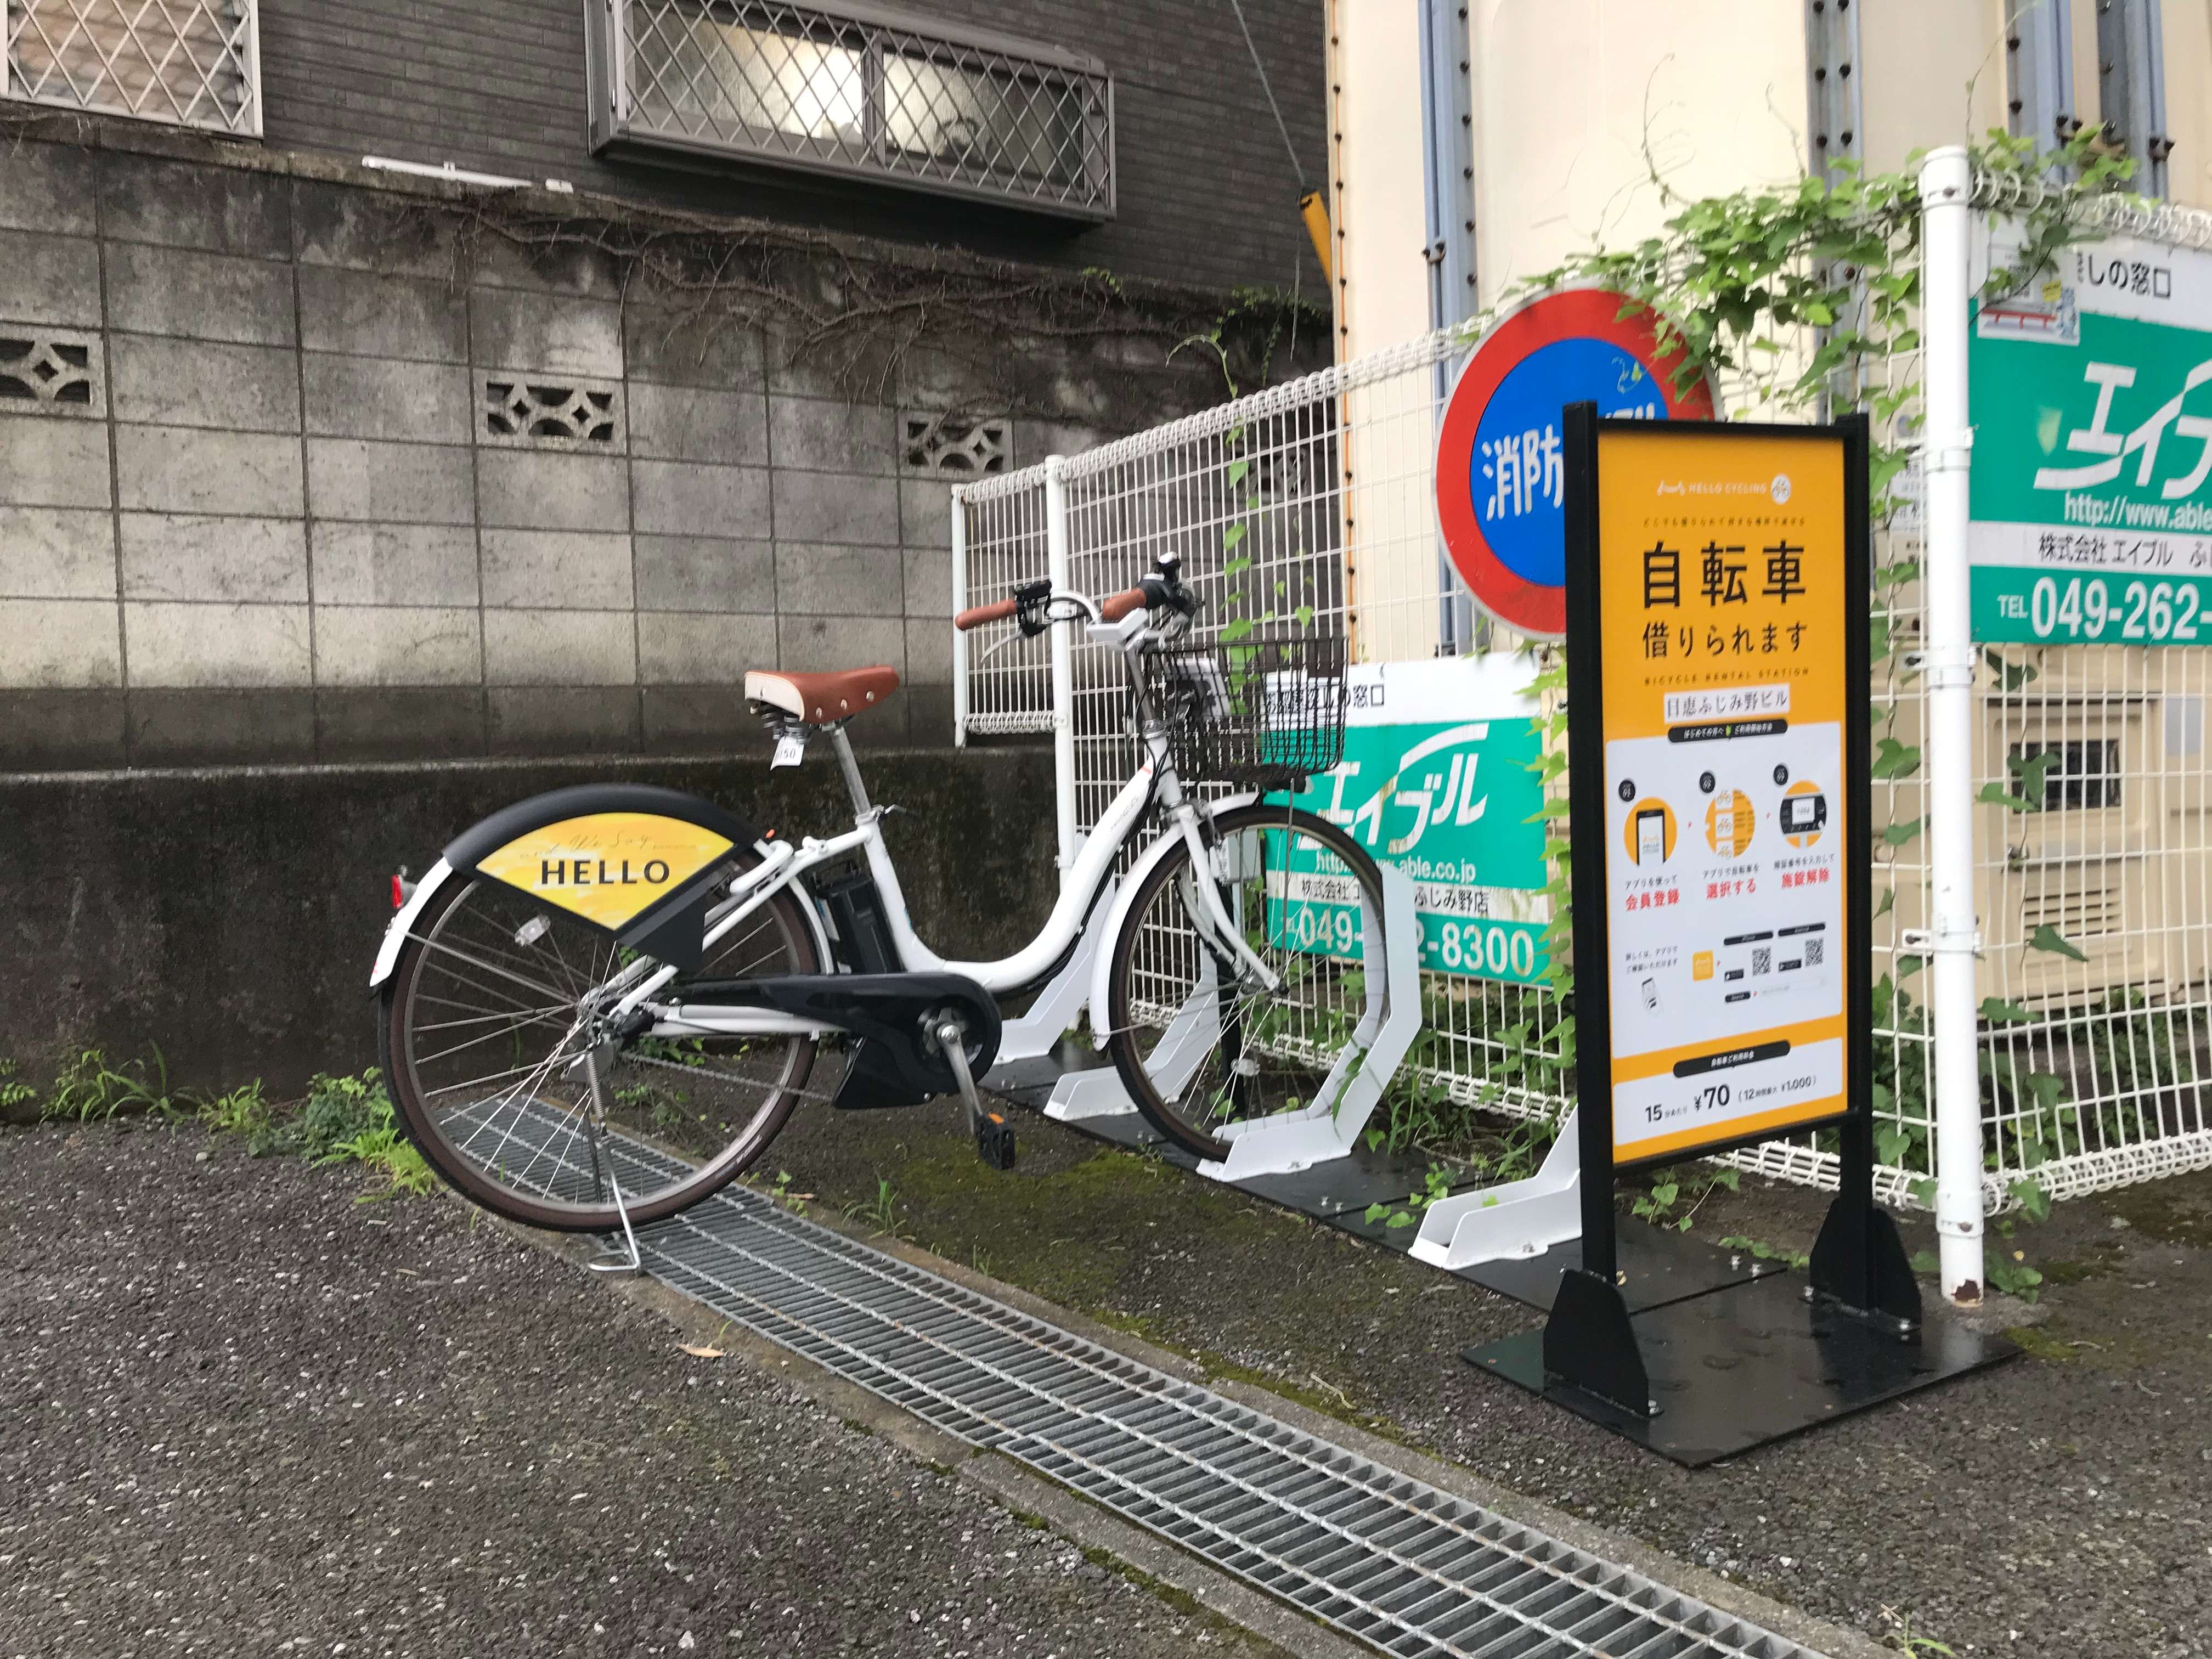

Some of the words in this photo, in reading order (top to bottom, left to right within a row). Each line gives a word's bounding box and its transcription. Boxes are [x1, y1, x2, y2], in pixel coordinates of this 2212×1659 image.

[1689, 482, 1723, 494] HELLO
[2039, 532, 2107, 564] 株式会社
[2112, 539, 2174, 567] エイブル
[1644, 539, 1806, 609] 自転車
[1997, 594, 2028, 619] TEL
[1643, 620, 1807, 659] 借りられます
[1758, 667, 1809, 678] STATION
[1297, 723, 1490, 855] エイブル
[541, 859, 670, 884] HELLO
[1626, 888, 1680, 912] 会員登録
[1706, 877, 1756, 899] 選択する
[1694, 1084, 1730, 1110] ¥70
